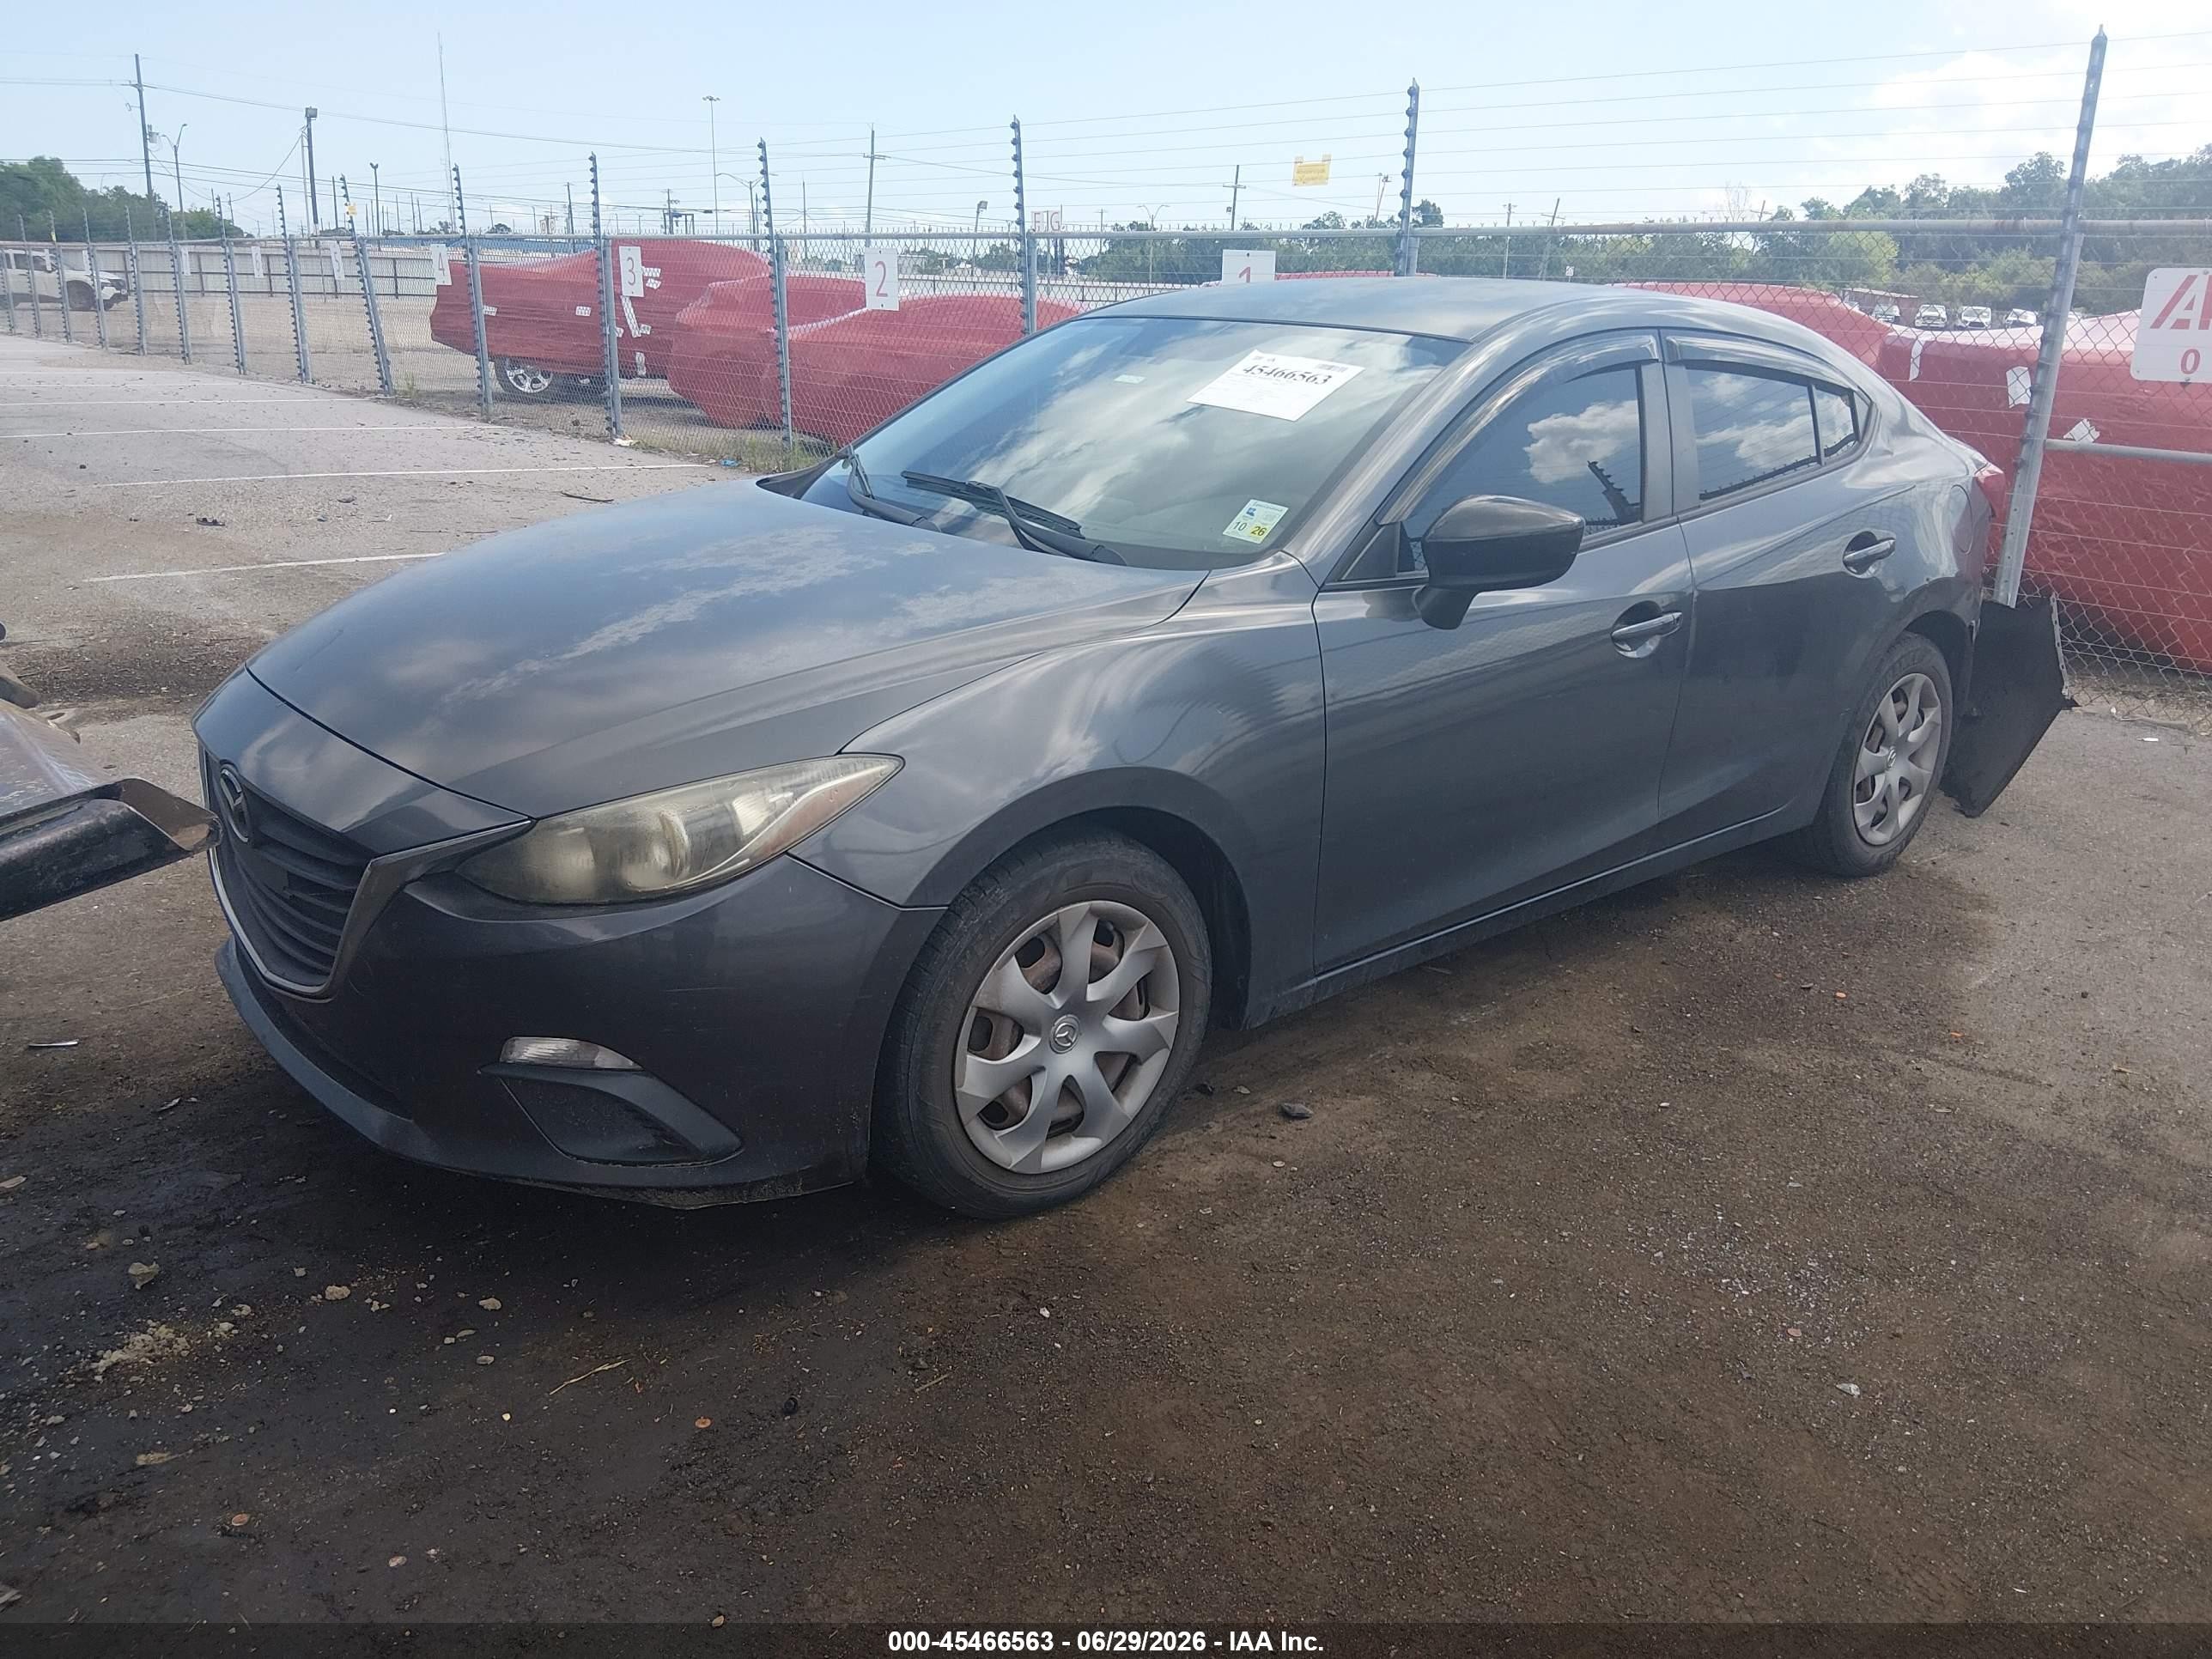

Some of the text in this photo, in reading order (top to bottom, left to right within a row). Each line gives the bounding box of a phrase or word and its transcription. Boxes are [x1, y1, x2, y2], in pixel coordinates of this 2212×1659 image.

[438, 252, 446, 276] 4
[626, 257, 636, 286] 3
[875, 260, 889, 298] 2
[1243, 364, 1334, 386] 45466563
[1233, 521, 1248, 532] 10
[1250, 526, 1267, 537] 26
